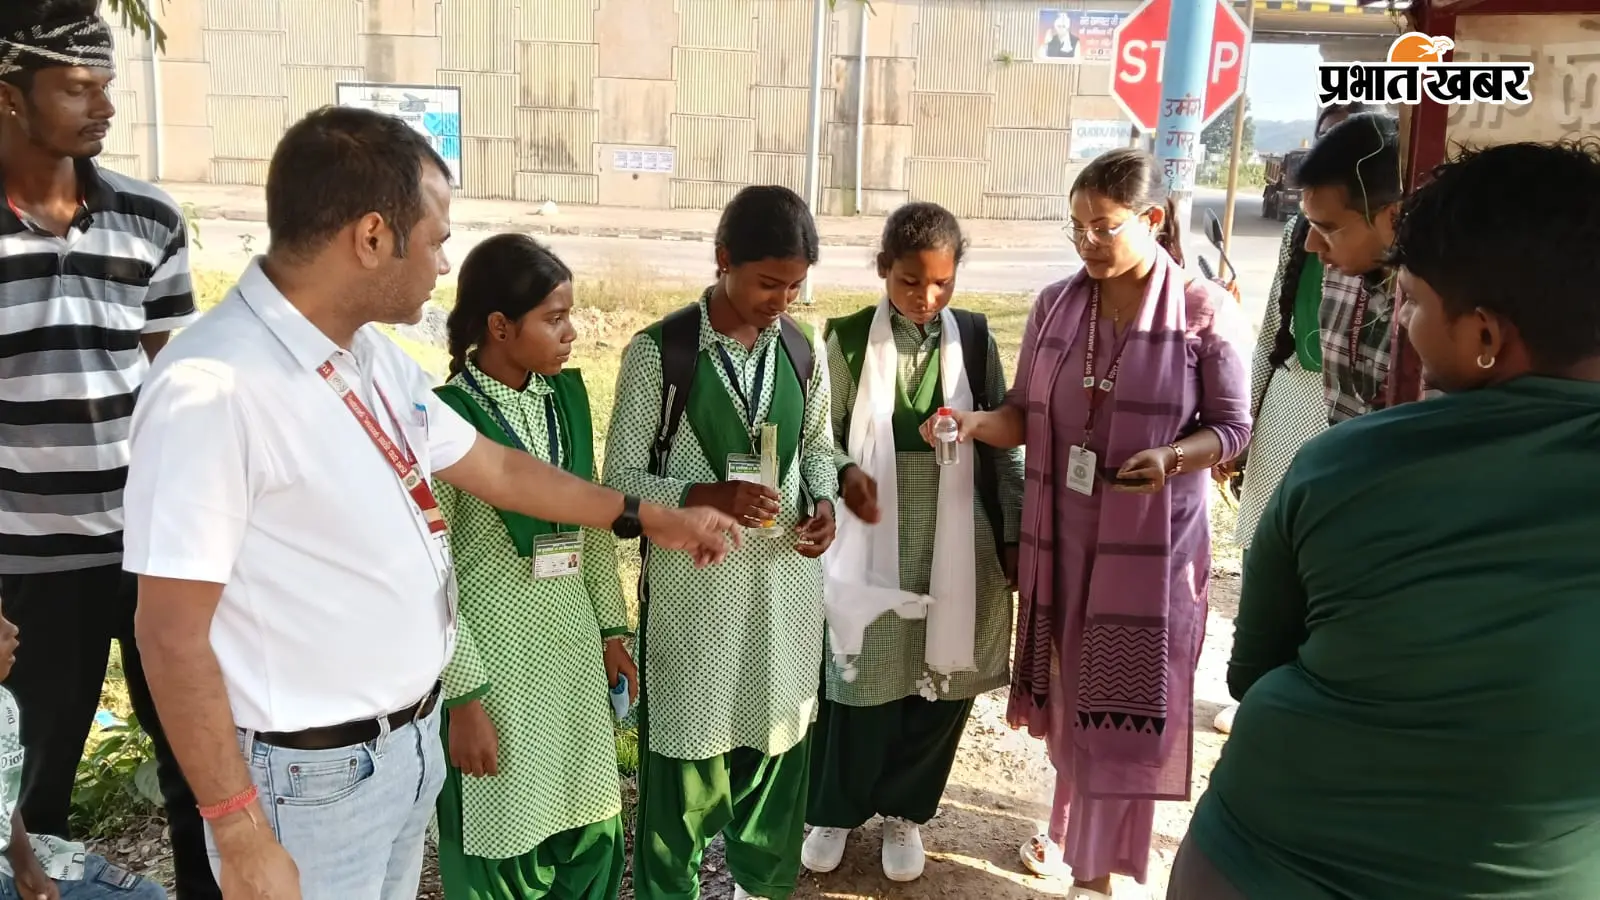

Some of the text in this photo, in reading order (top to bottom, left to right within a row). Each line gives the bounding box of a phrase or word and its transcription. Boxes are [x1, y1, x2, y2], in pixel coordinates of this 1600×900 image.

[1120, 40, 1239, 84] STP
[7, 706, 16, 725] Dior
[1, 751, 23, 768] Dior
